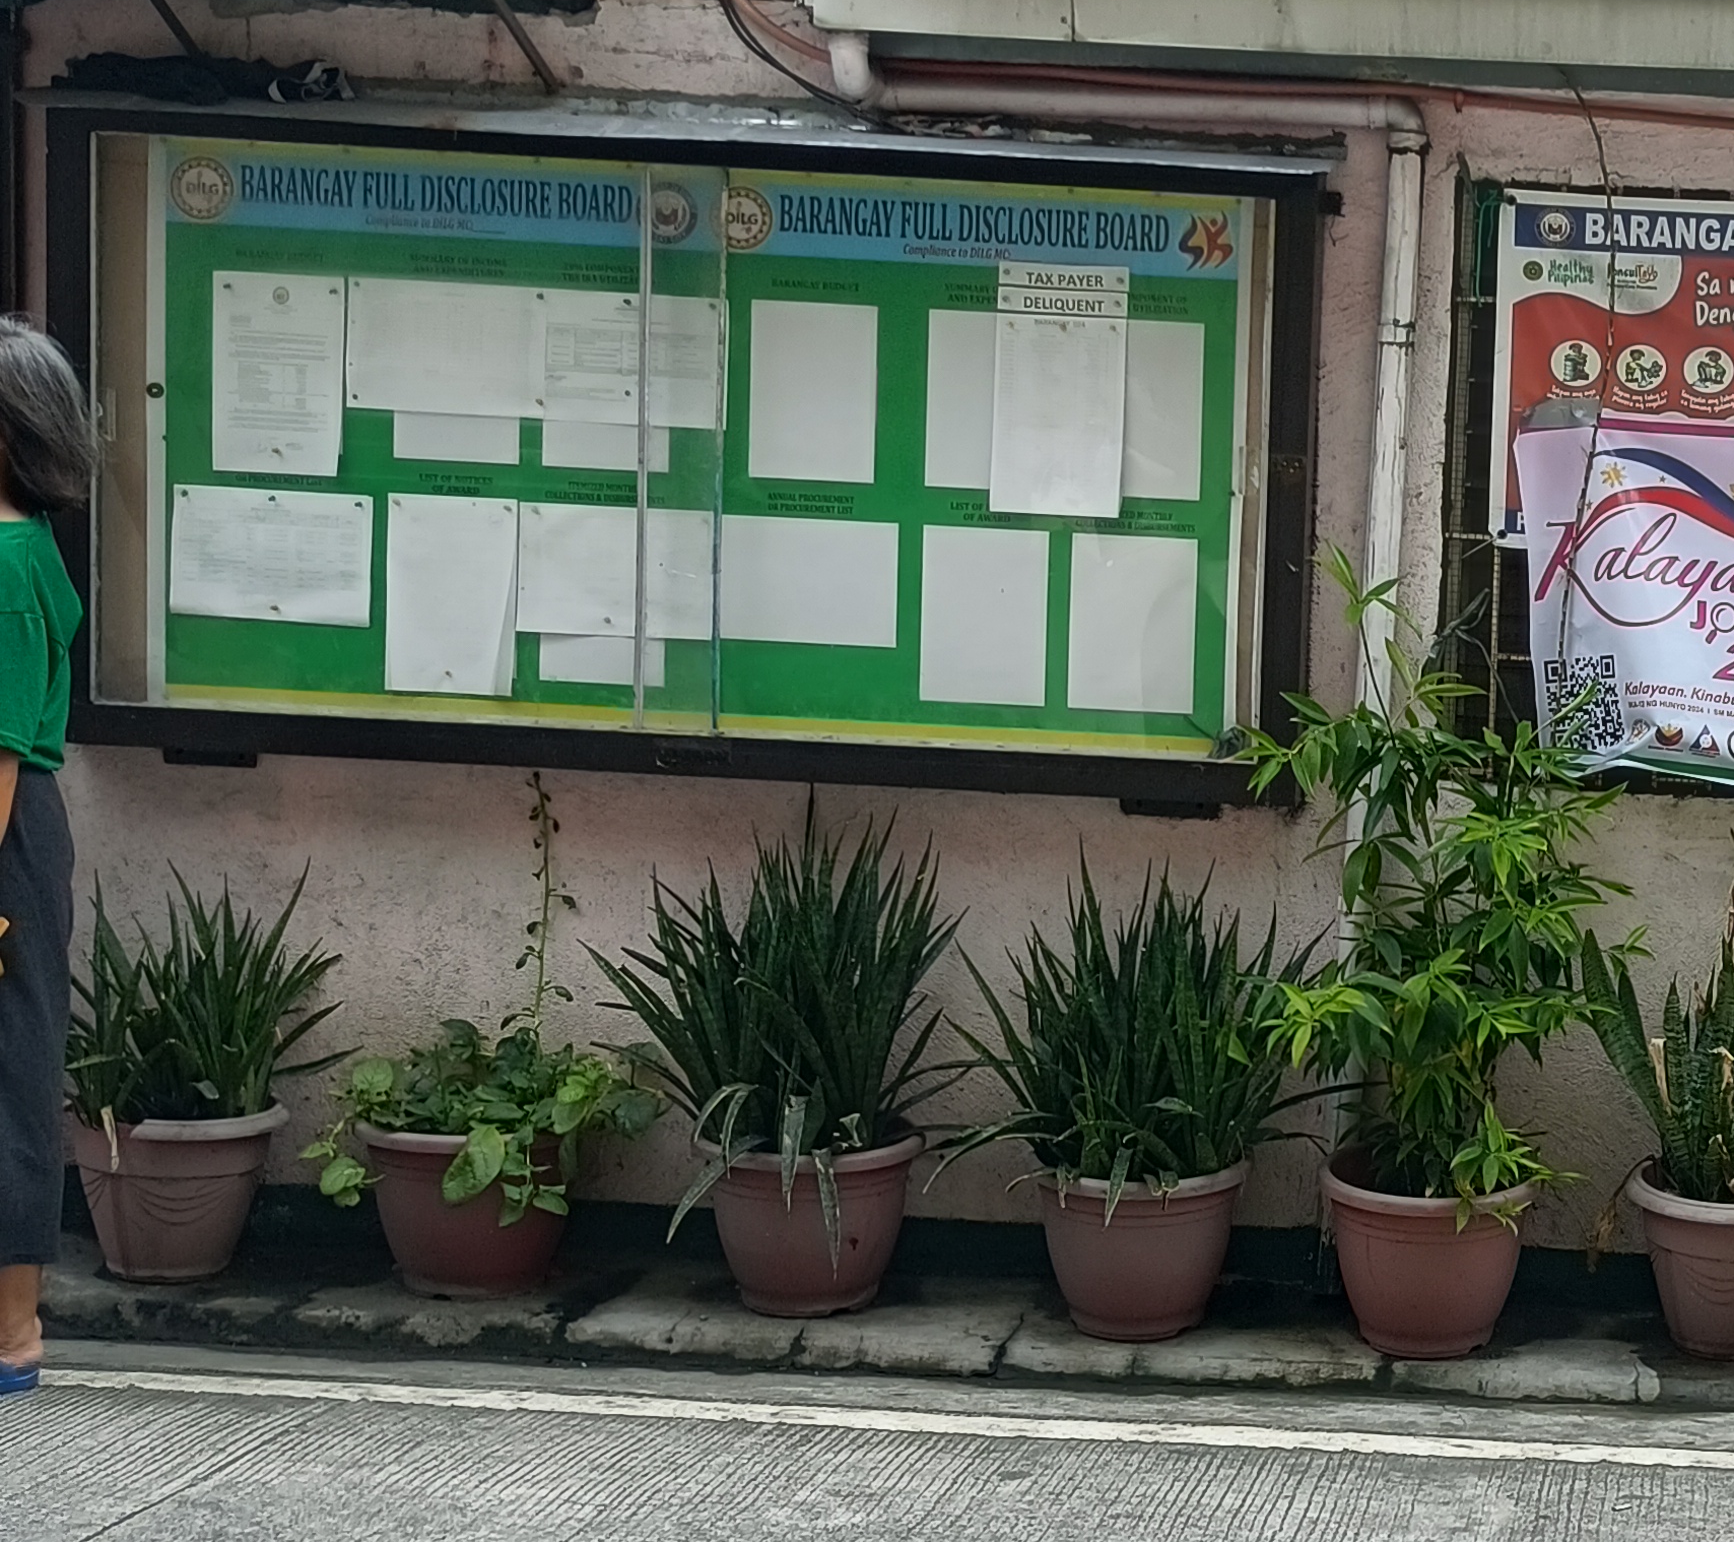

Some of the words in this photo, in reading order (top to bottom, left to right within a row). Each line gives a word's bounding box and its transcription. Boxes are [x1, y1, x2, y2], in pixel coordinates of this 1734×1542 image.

[240, 165, 356, 208] BARANGAY
[362, 171, 411, 211] FULL
[420, 175, 551, 219] DISCLOSURE
[558, 183, 633, 223] BOARD
[779, 194, 895, 237] BARANGAY
[901, 204, 951, 240] FULL
[959, 207, 1089, 250] DISCLOSURE
[1096, 215, 1169, 252] BOARD
[1550, 260, 1594, 277] Healthy
[1025, 272, 1053, 287] TAX
[1058, 273, 1104, 288] PAYER
[1548, 270, 1594, 287] Pilipinas
[1696, 273, 1722, 296] Sa
[1023, 295, 1105, 312] DELIQUENT
[1625, 682, 1687, 699] Kalayaan.
